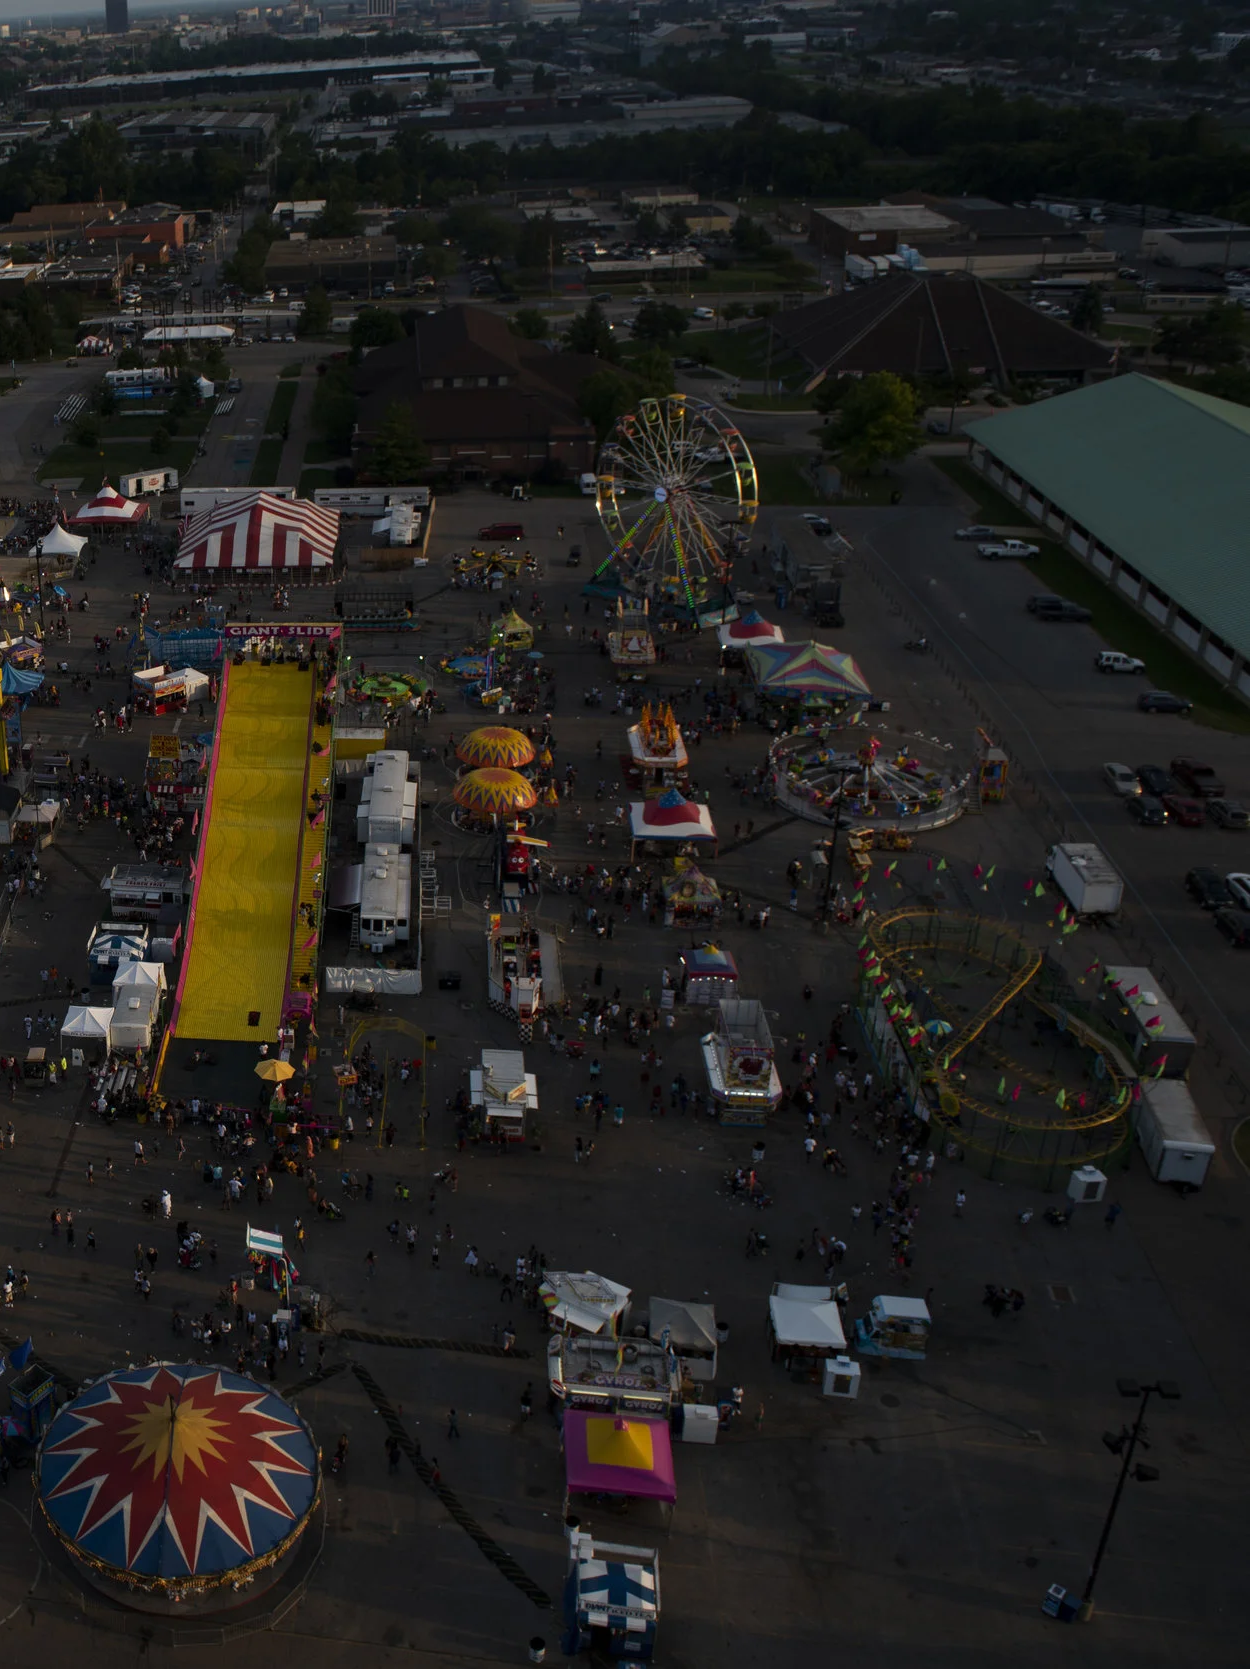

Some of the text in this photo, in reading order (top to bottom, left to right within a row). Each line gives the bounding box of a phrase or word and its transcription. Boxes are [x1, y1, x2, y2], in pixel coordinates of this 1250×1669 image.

[229, 626, 334, 636] GIANT SLIDE
[594, 1375, 641, 1387] GYROS
[571, 1395, 610, 1405] GYROS
[625, 1400, 663, 1410] GYROS
